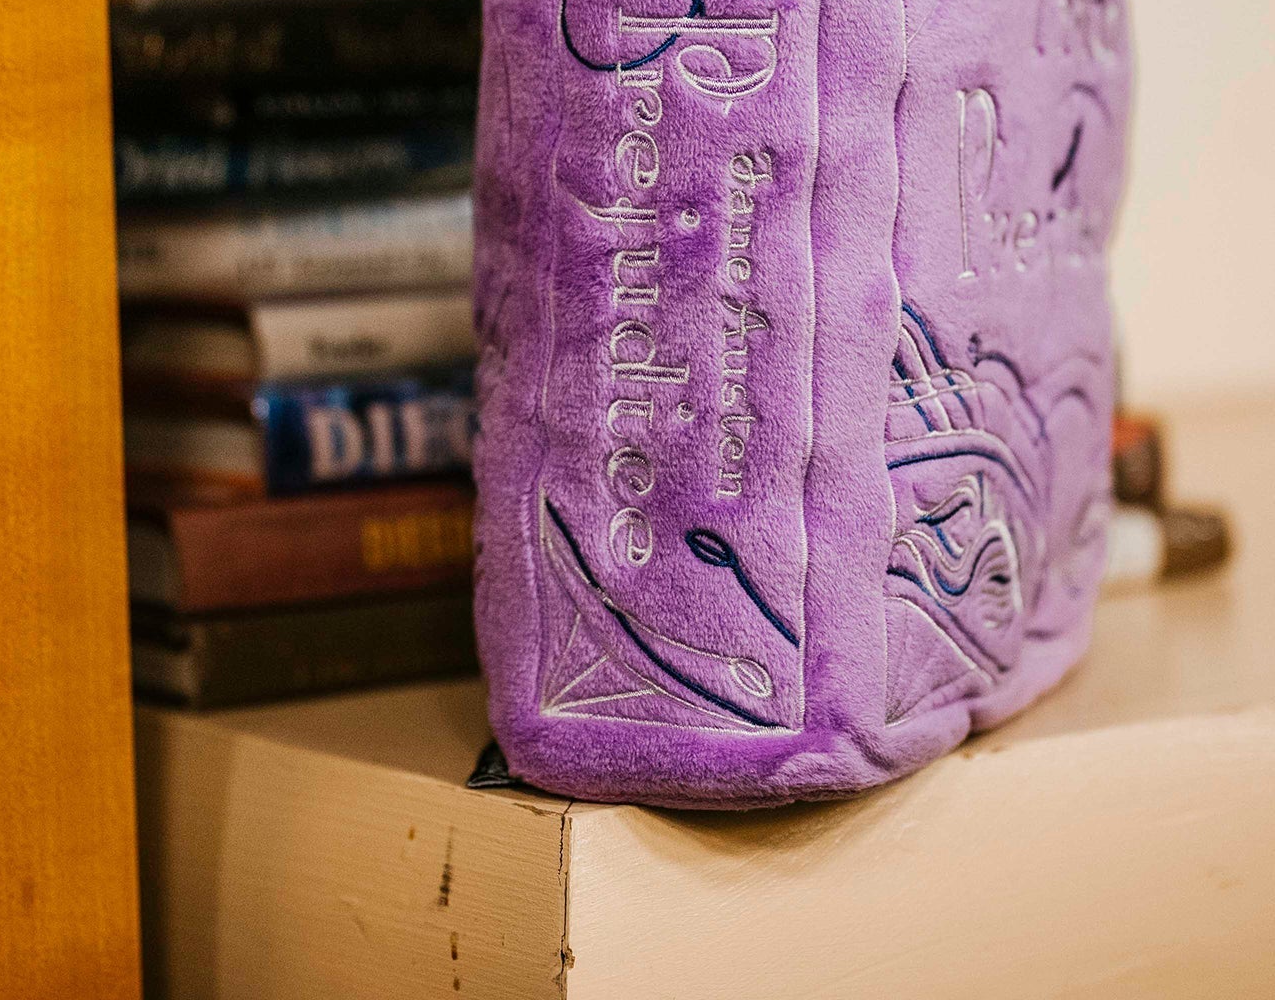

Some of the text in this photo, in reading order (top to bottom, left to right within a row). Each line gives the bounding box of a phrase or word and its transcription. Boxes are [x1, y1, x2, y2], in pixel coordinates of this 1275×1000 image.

[576, 6, 779, 566] Prejudice
[716, 150, 774, 500] Jane Austen
